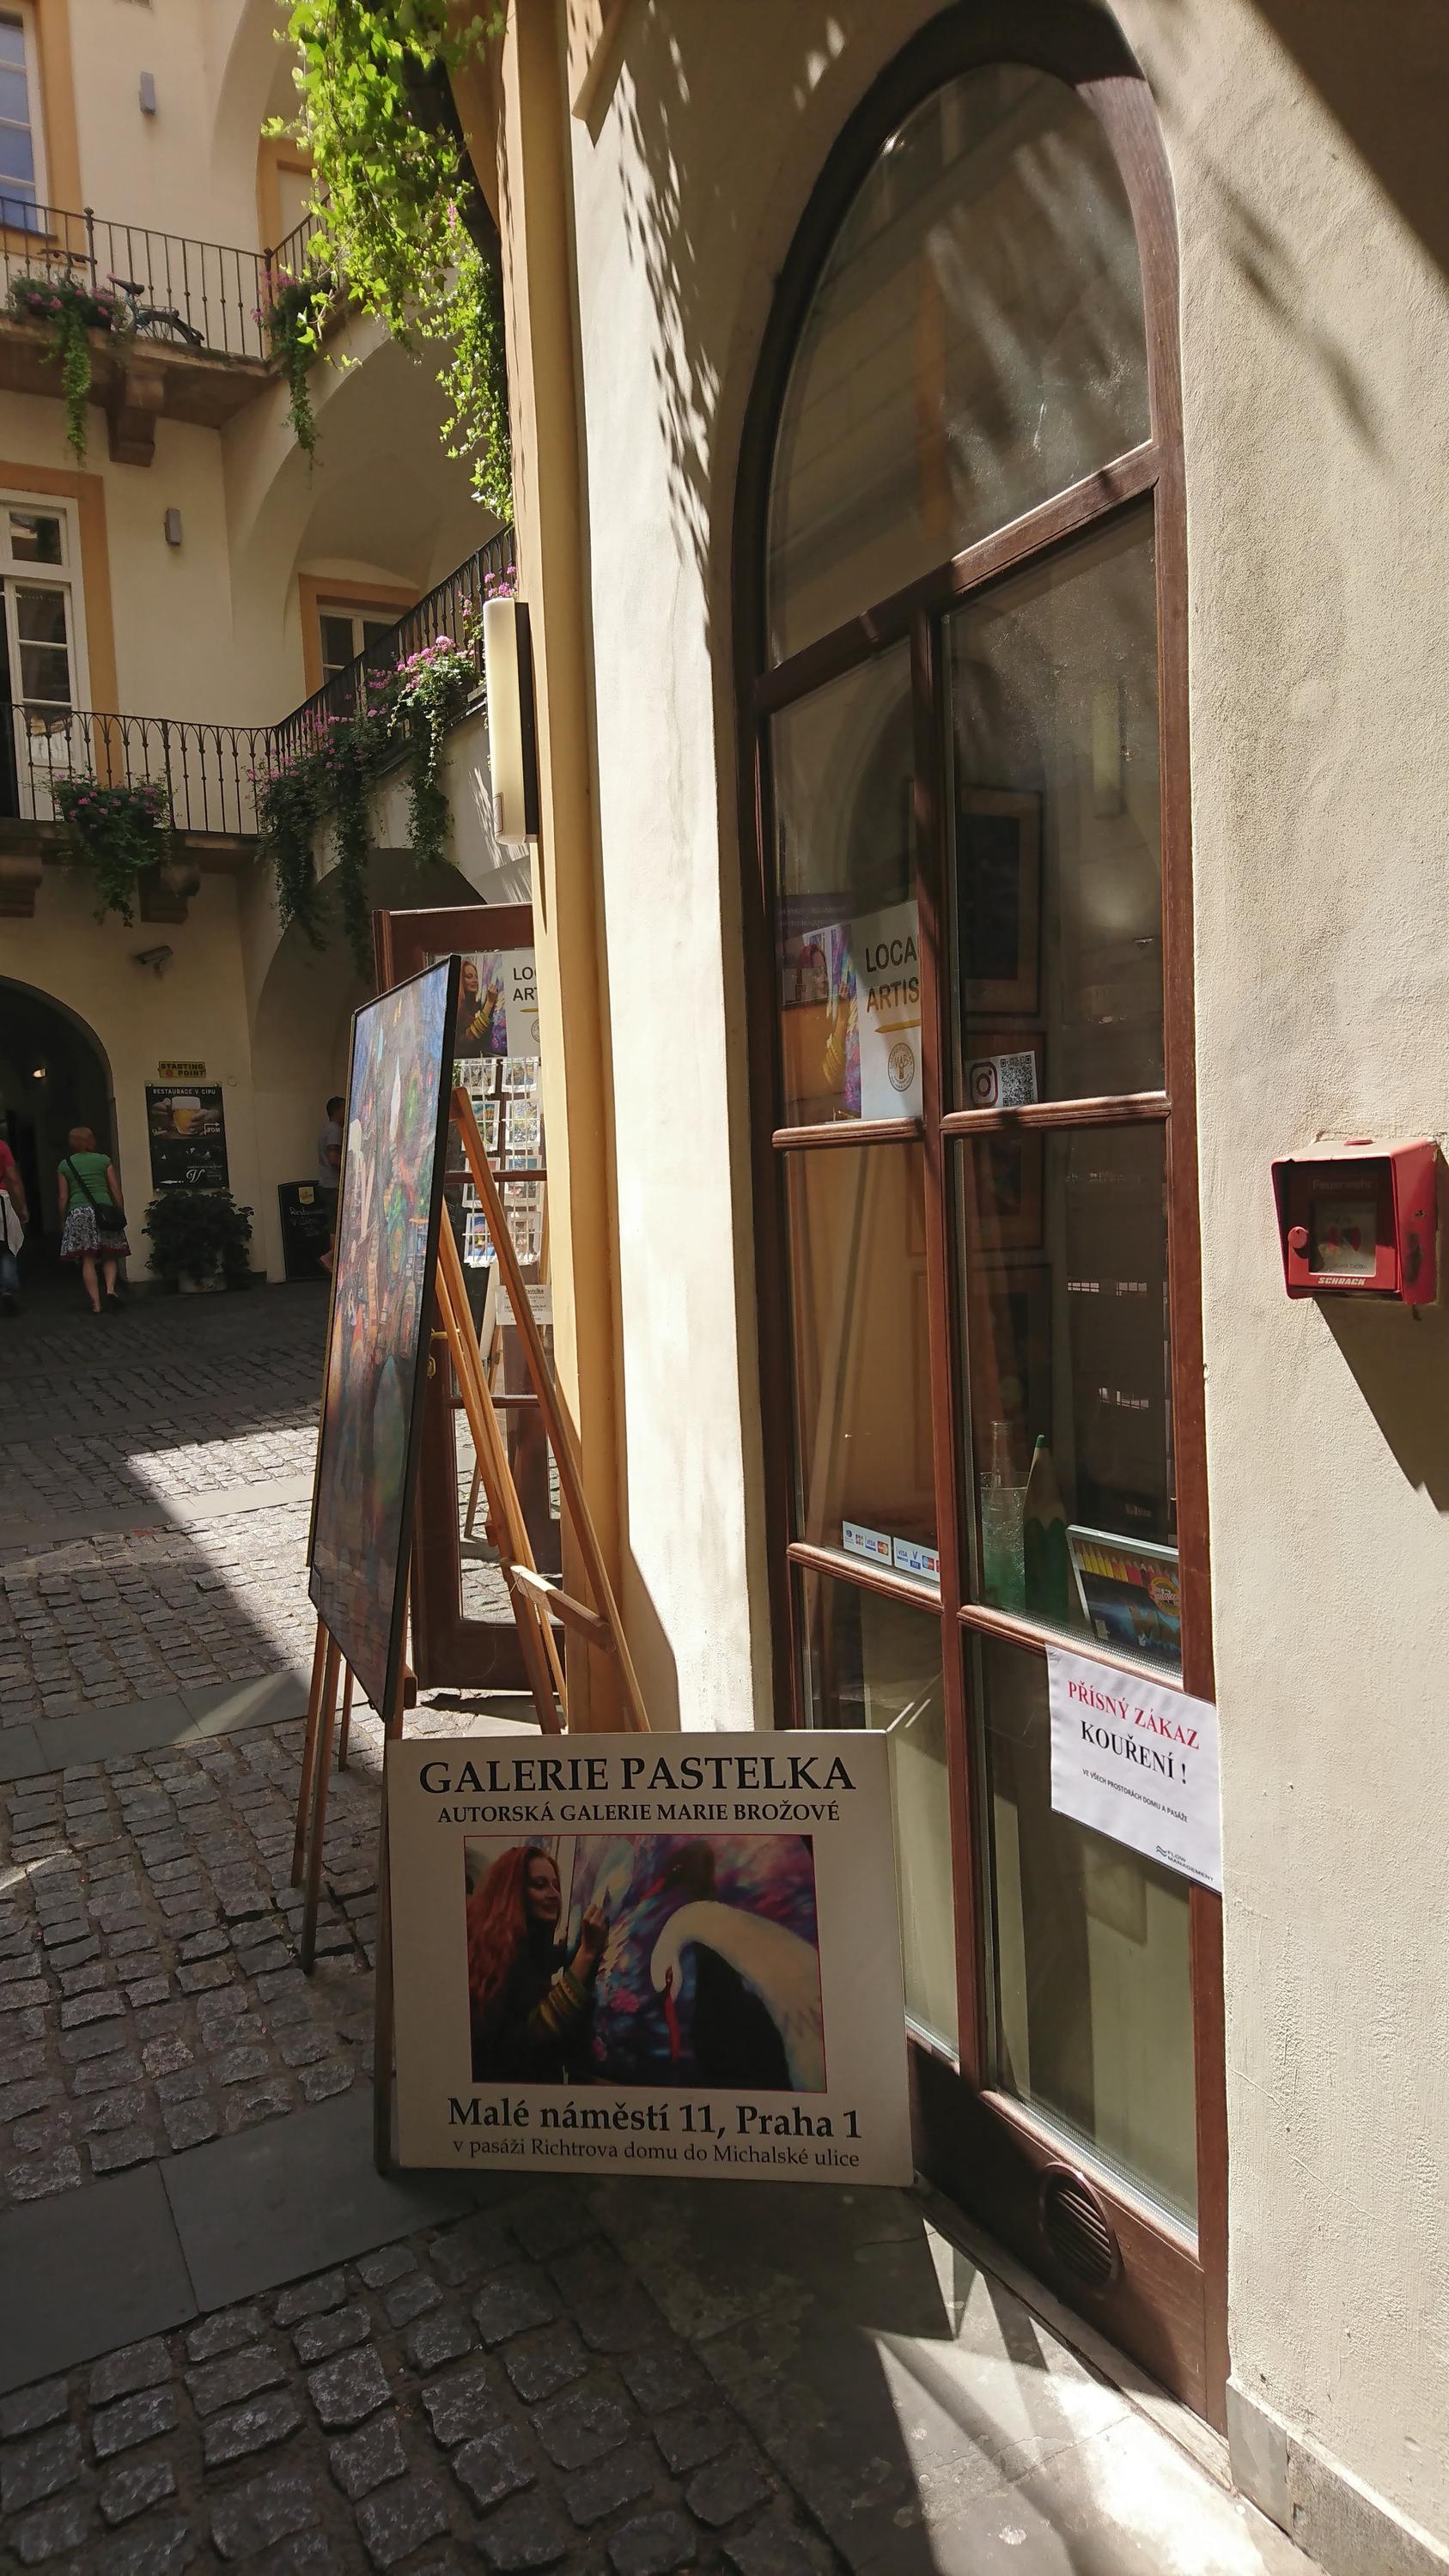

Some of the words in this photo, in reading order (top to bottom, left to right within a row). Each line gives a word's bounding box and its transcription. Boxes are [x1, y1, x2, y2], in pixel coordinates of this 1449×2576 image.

[865, 936, 917, 974] LOCA
[513, 967, 538, 981] LO
[867, 976, 920, 1013] ARTIS
[1318, 1277, 1366, 1286] SCHRACK
[866, 1539, 876, 1547] VISA
[1068, 1680, 1129, 1721] PŘÍSNÝ
[1134, 1707, 1199, 1750] ZÁKAZ
[1080, 1720, 1175, 1780] KOUŘENÍ
[419, 1759, 609, 1794] GALERIE
[620, 1757, 856, 1790] PASTELKA
[437, 1801, 555, 1823] AUTORSKÁ
[560, 1804, 651, 1821] GALERIE
[656, 1803, 728, 1821] MARIE
[734, 1799, 840, 1821] BROŽOVÉ
[1082, 1768, 1089, 1777] VE
[1090, 1771, 1107, 1784] VŠECH
[1107, 1780, 1142, 1801] PROSTORÁCH
[1142, 1796, 1161, 1810] DOMU
[1166, 1807, 1189, 1823] PASÁŽE
[1166, 1850, 1187, 1862] FLOW
[1166, 1856, 1214, 1882] MANAGEMENT
[447, 2097, 530, 2127] Malé
[539, 2101, 670, 2131] náměstí
[679, 2104, 726, 2140] 11,
[736, 2105, 834, 2138] Praha
[843, 2110, 861, 2139] 1
[453, 2141, 464, 2153] v
[469, 2137, 525, 2158] pasáži
[531, 2138, 618, 2158] Richtrova
[624, 2142, 678, 2160] domu
[684, 2143, 708, 2161] do
[714, 2144, 809, 2165] Michalské
[814, 2148, 860, 2167] ulice
